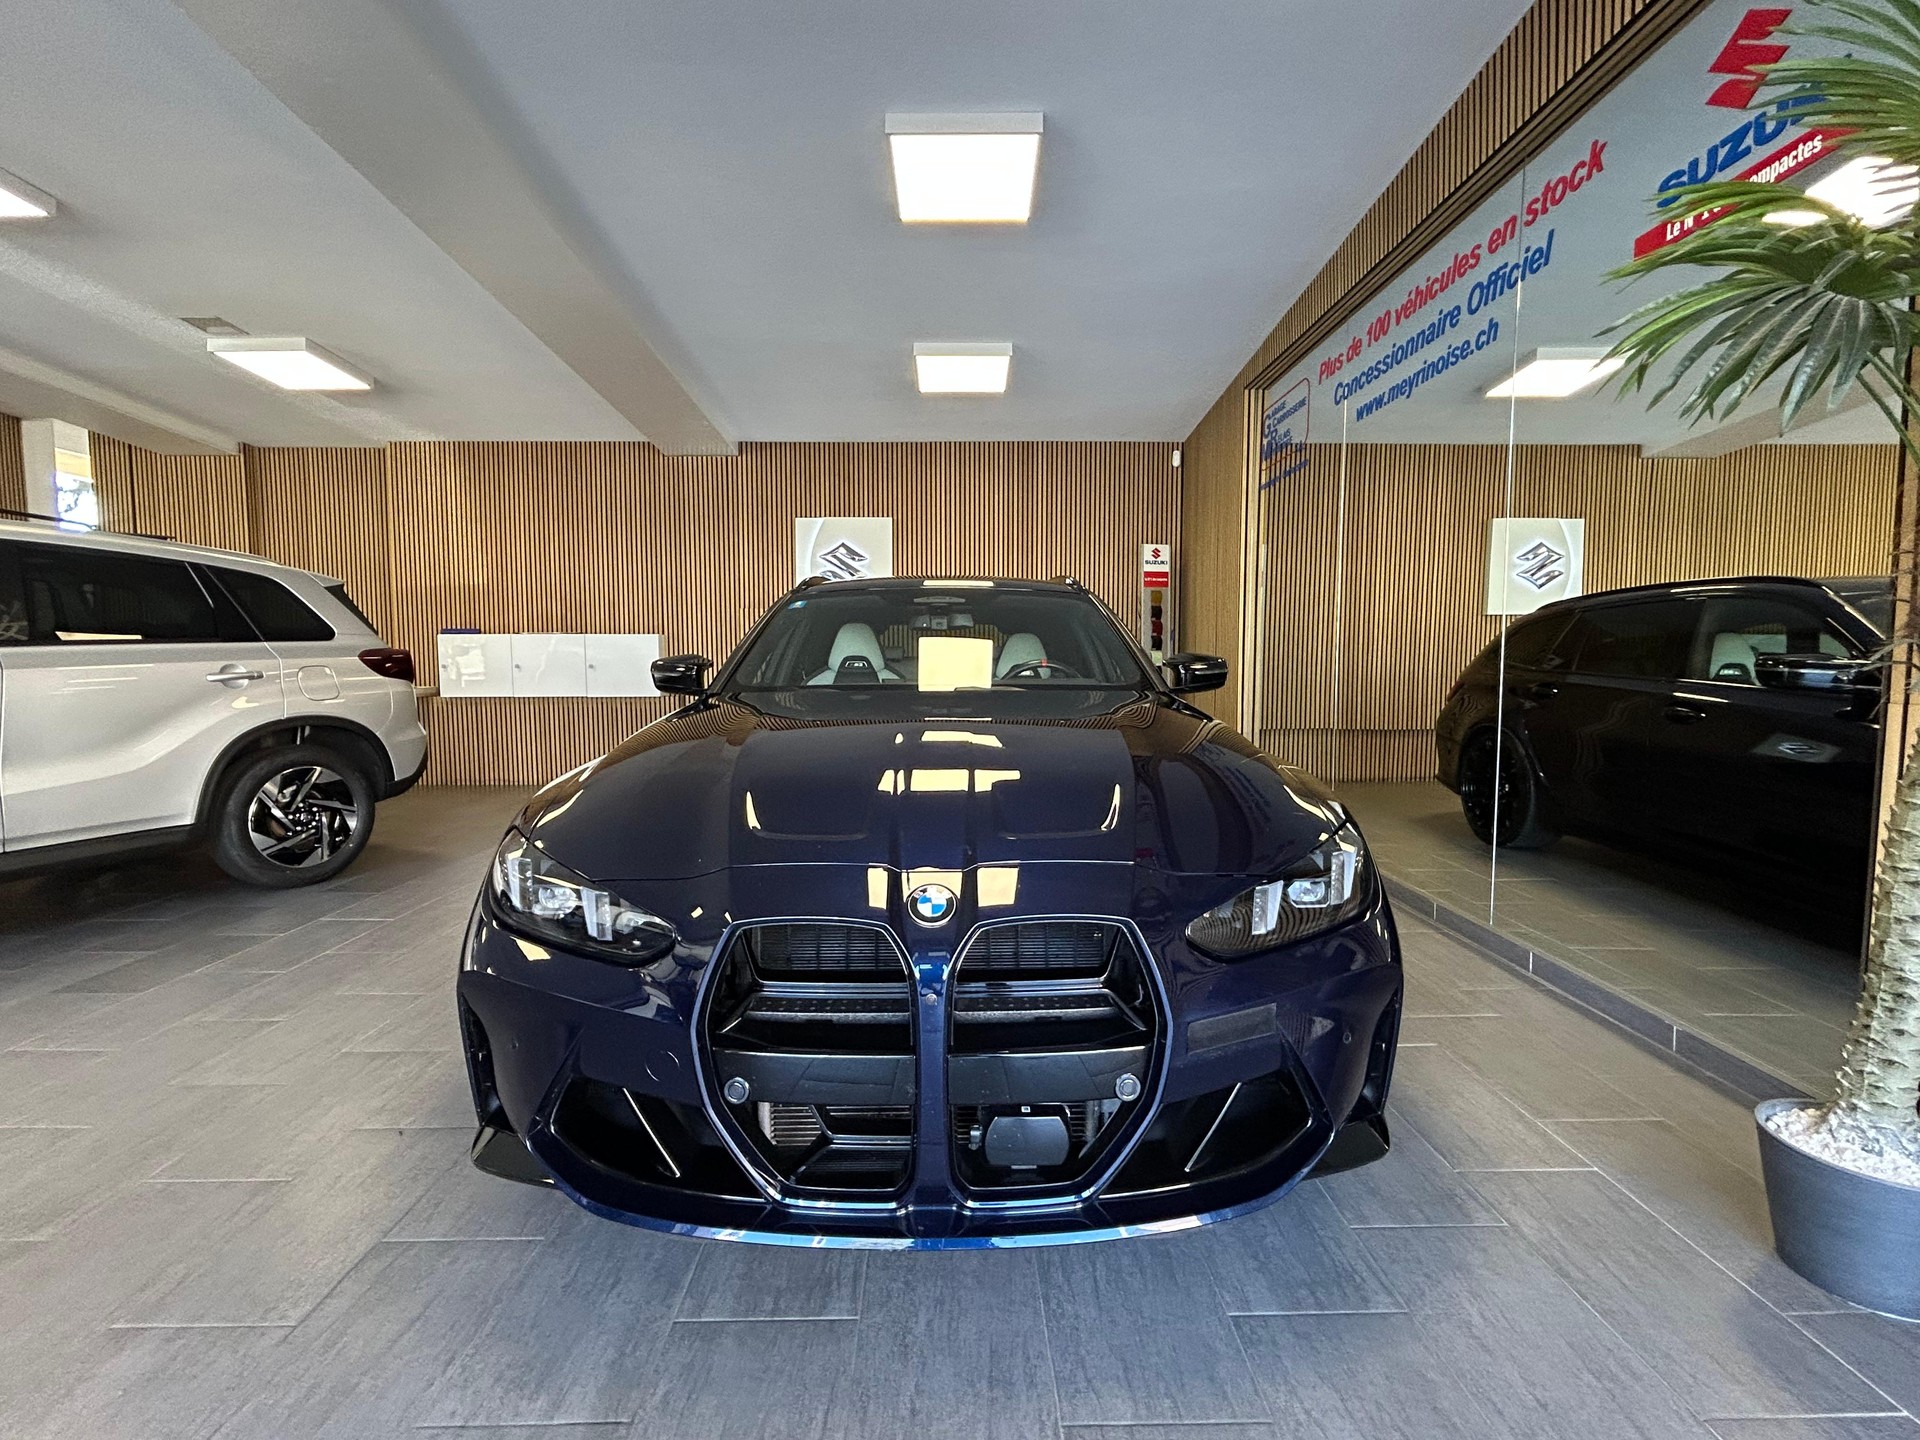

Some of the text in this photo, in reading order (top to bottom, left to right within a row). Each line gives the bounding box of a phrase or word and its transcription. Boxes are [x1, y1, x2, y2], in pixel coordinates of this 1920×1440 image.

[1666, 221, 1681, 241] Le
[1745, 133, 1823, 184] ompactes
[1318, 140, 1607, 385] Plus de 100 véhicules en stock
[1334, 228, 1555, 406] Concessionnaire Officiel
[1356, 318, 1498, 422] www.meyrinoise.ch
